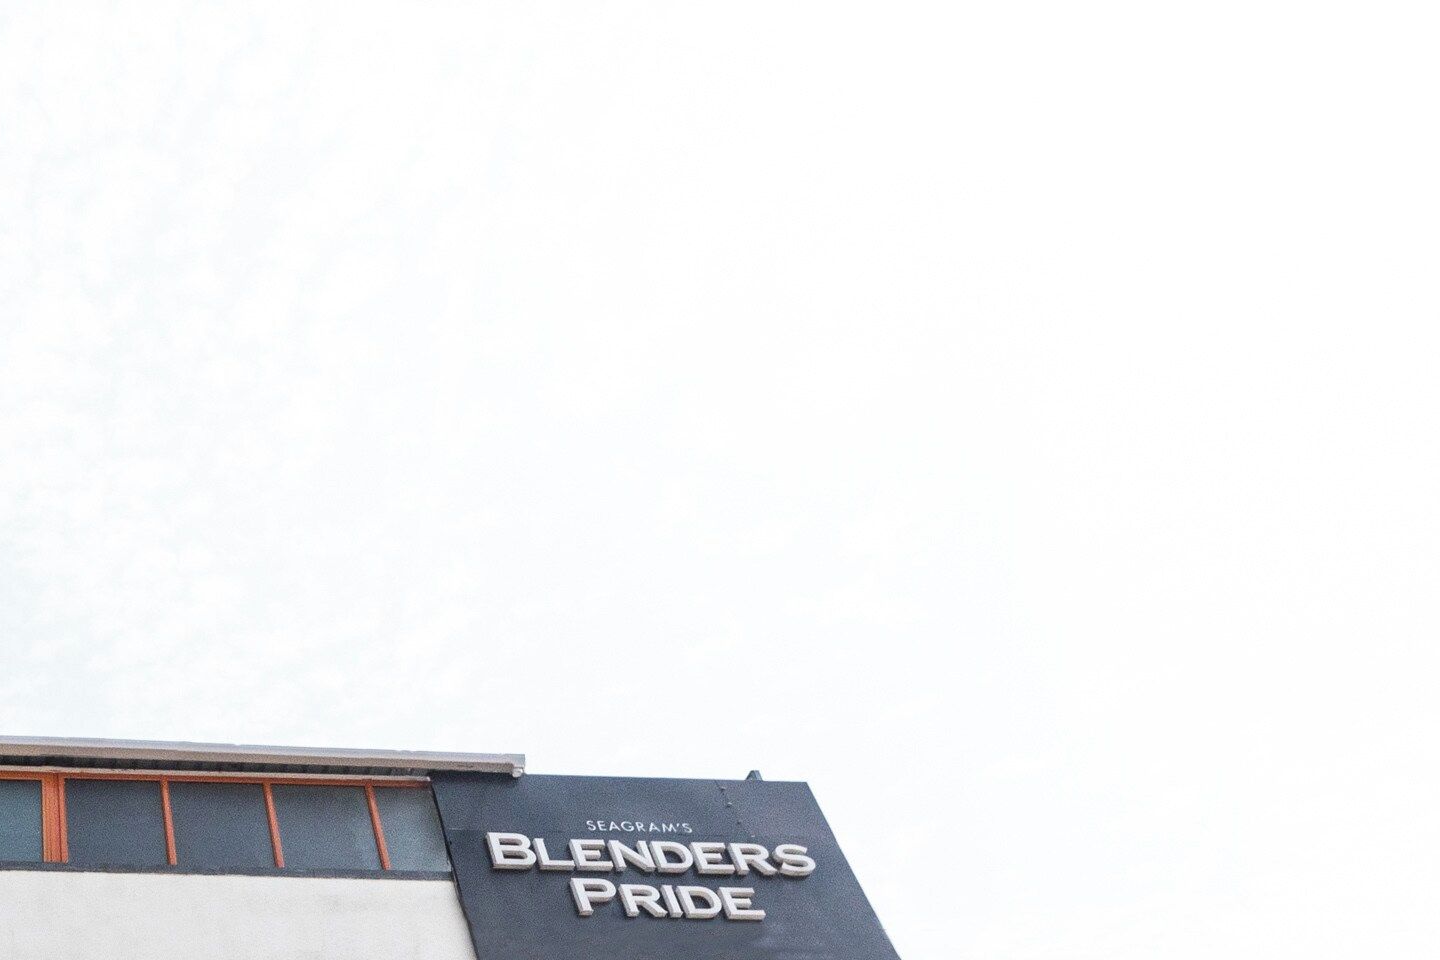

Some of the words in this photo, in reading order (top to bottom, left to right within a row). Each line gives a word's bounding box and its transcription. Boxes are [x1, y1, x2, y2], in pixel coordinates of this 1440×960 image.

[586, 820, 693, 834] SEAGRAM'S
[485, 831, 816, 877] BLENDERS
[570, 877, 766, 921] PRIDE
